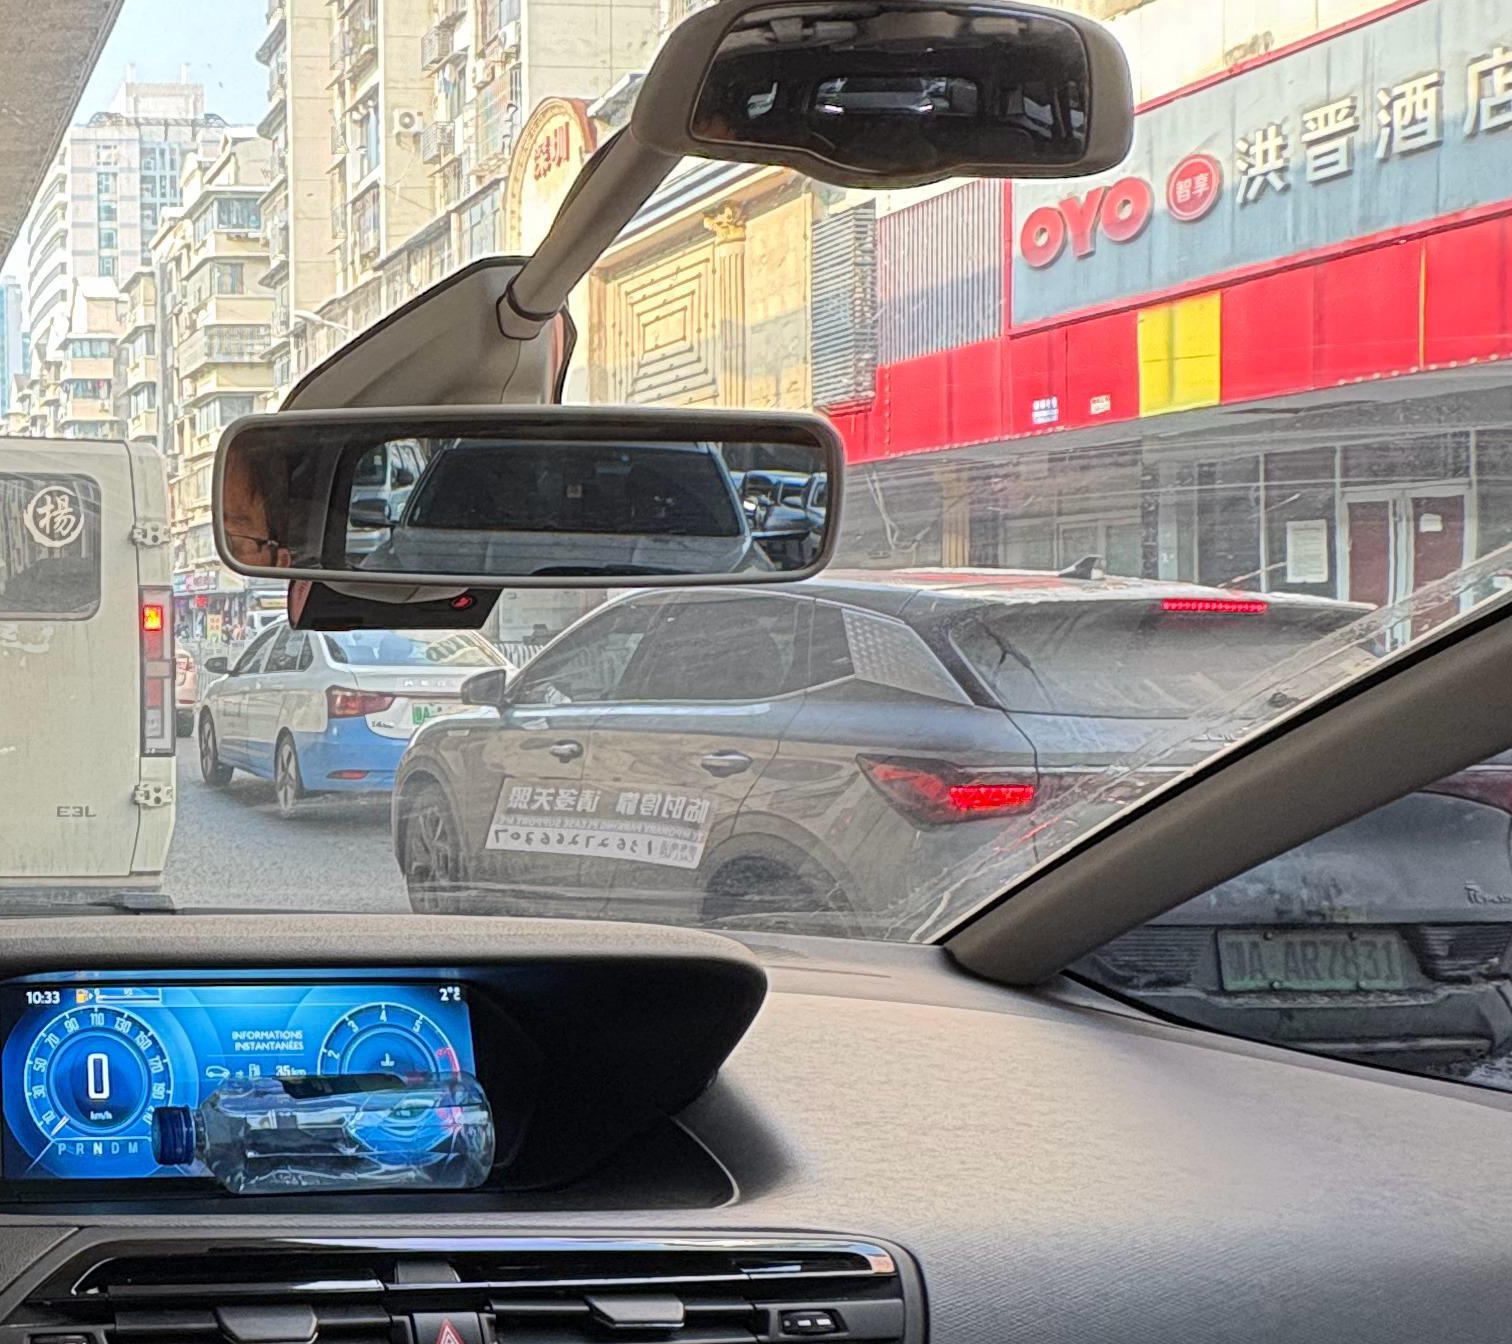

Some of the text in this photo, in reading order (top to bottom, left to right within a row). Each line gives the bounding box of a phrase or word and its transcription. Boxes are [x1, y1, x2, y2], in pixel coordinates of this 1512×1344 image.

[1175, 171, 1209, 202] 智享
[1020, 176, 1153, 268] OYO
[25, 991, 61, 1006] 10:33
[90, 1013, 104, 1026] 110
[379, 1010, 387, 1023] 4
[64, 1018, 80, 1033] 90
[114, 1017, 132, 1034] 130
[347, 1020, 359, 1034] 3
[412, 1019, 423, 1033] 5
[44, 1033, 60, 1049] 70
[134, 1031, 153, 1051] 150
[232, 1030, 303, 1040] INFORMATIONS
[327, 1049, 341, 1060] 2
[148, 1055, 164, 1074] 170
[87, 1053, 110, 1100] 0
[90, 1111, 113, 1120] km/h
[58, 1142, 140, 1155] P R N D M
